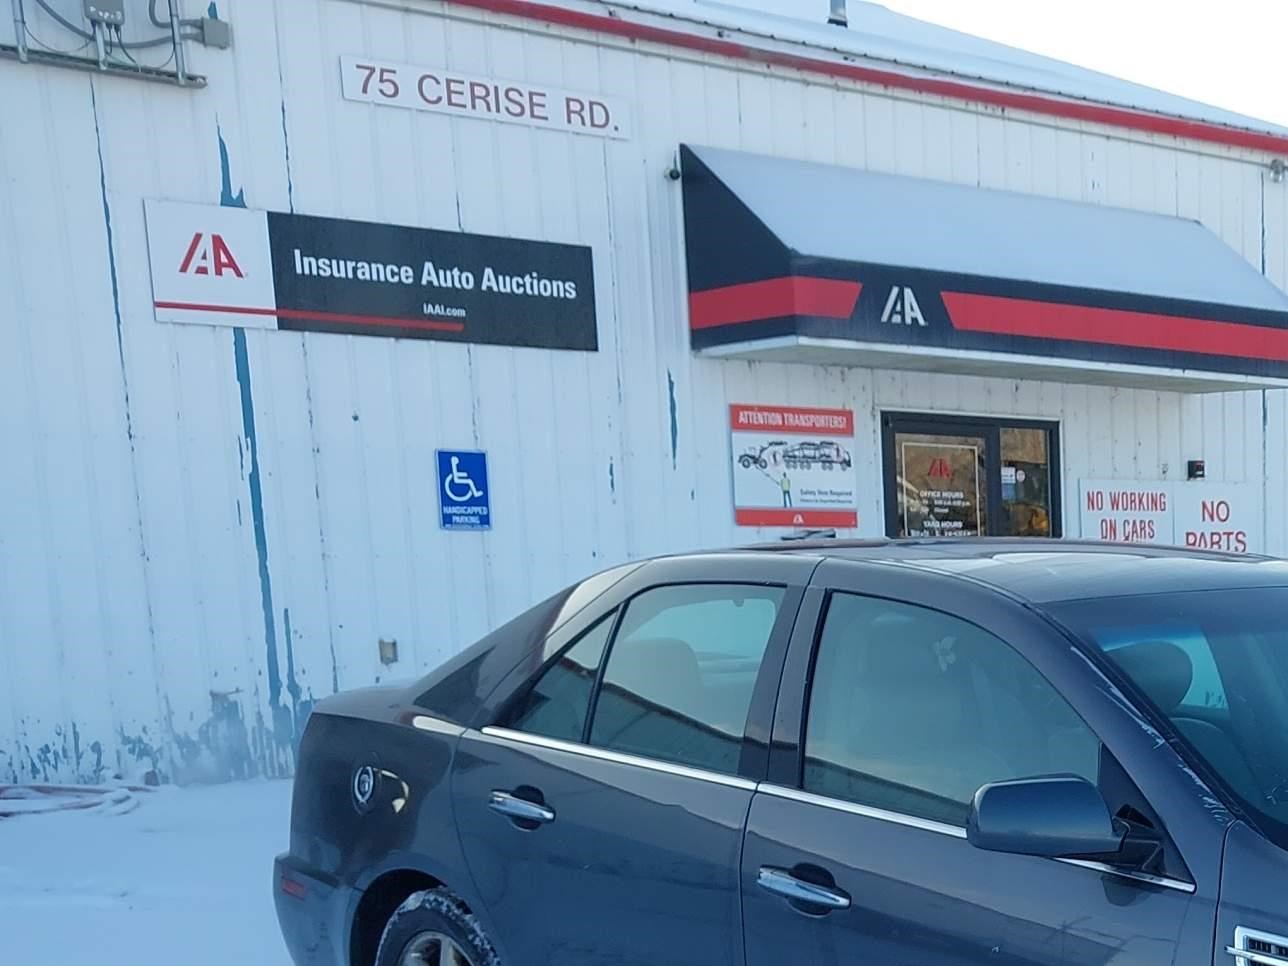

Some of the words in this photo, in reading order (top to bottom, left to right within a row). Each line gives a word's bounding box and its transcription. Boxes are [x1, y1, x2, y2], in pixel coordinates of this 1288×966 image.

[355, 64, 400, 99] 75
[417, 74, 550, 121] CERISE
[565, 97, 620, 132] RD.
[293, 248, 414, 285] Insurance
[421, 262, 475, 290] Auto
[480, 267, 578, 300] Auctions
[423, 302, 467, 318] IAAI.com
[1086, 491, 1104, 512] NO
[1109, 491, 1167, 513] WORKING
[1201, 500, 1231, 523] NO
[1100, 518, 1117, 541] ON
[1122, 519, 1156, 542] CARS
